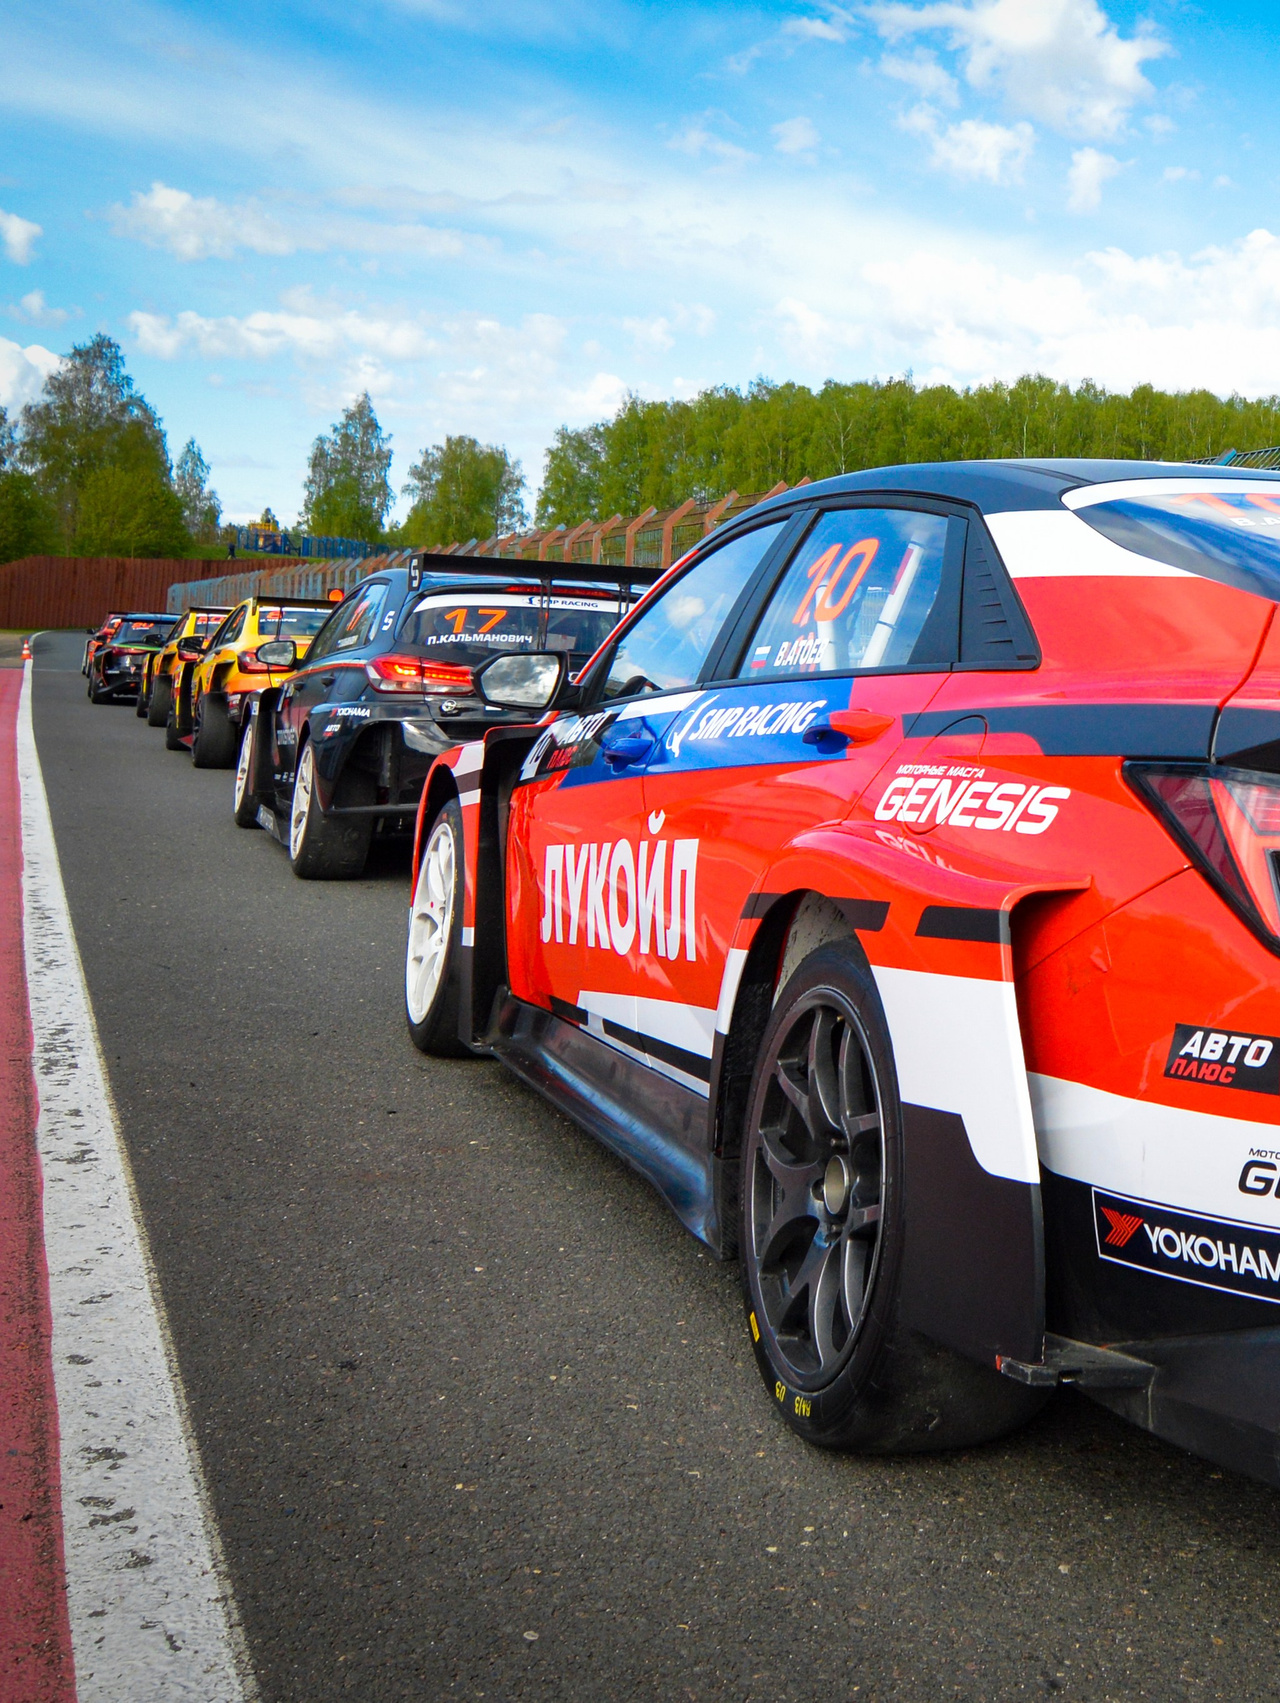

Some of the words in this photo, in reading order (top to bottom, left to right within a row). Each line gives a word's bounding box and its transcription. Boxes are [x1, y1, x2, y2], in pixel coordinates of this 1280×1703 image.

[792, 537, 881, 625] 10
[444, 608, 508, 634] 17
[561, 600, 599, 608] RACING
[427, 633, 533, 646] П.КАЛЬМАНОВИЧ
[688, 706, 736, 741] SMP
[728, 700, 828, 738] RACING
[874, 776, 1071, 835] GENESIS
[540, 809, 700, 962] ЛУКОЙЛ
[1178, 1030, 1274, 1069] АВТО
[1169, 1056, 1237, 1084] ПЛЮС
